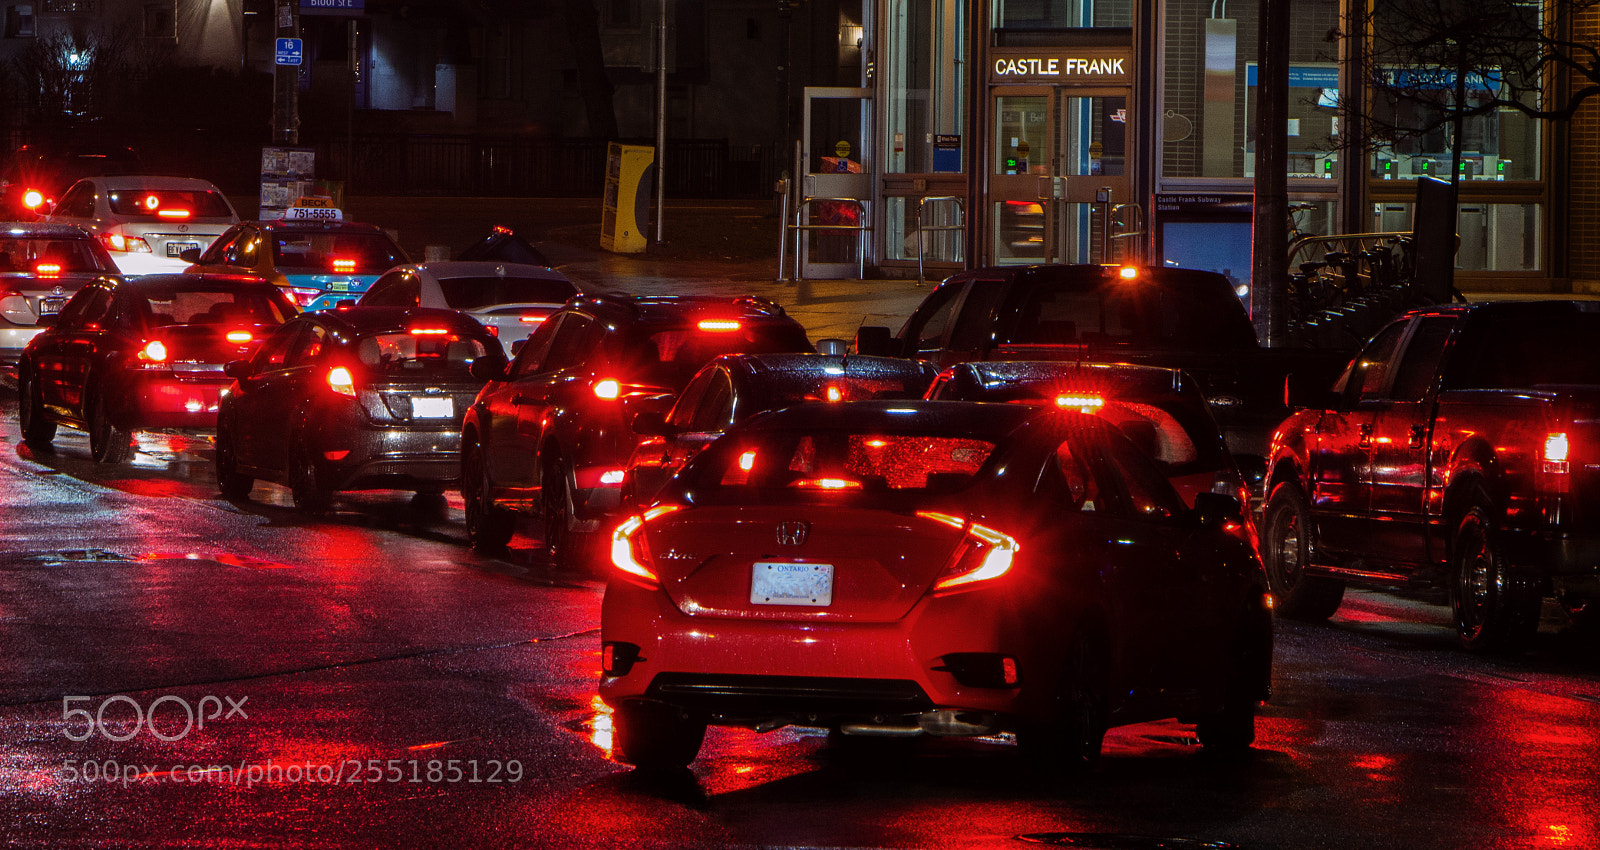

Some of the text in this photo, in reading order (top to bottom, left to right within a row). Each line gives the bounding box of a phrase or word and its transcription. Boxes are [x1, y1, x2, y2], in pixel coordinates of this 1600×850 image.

[284, 41, 294, 50] 16
[995, 58, 1125, 75] CASTLE FRANK
[301, 199, 327, 207] BECK
[1197, 196, 1222, 204] Subway
[293, 208, 337, 219] 751-5555
